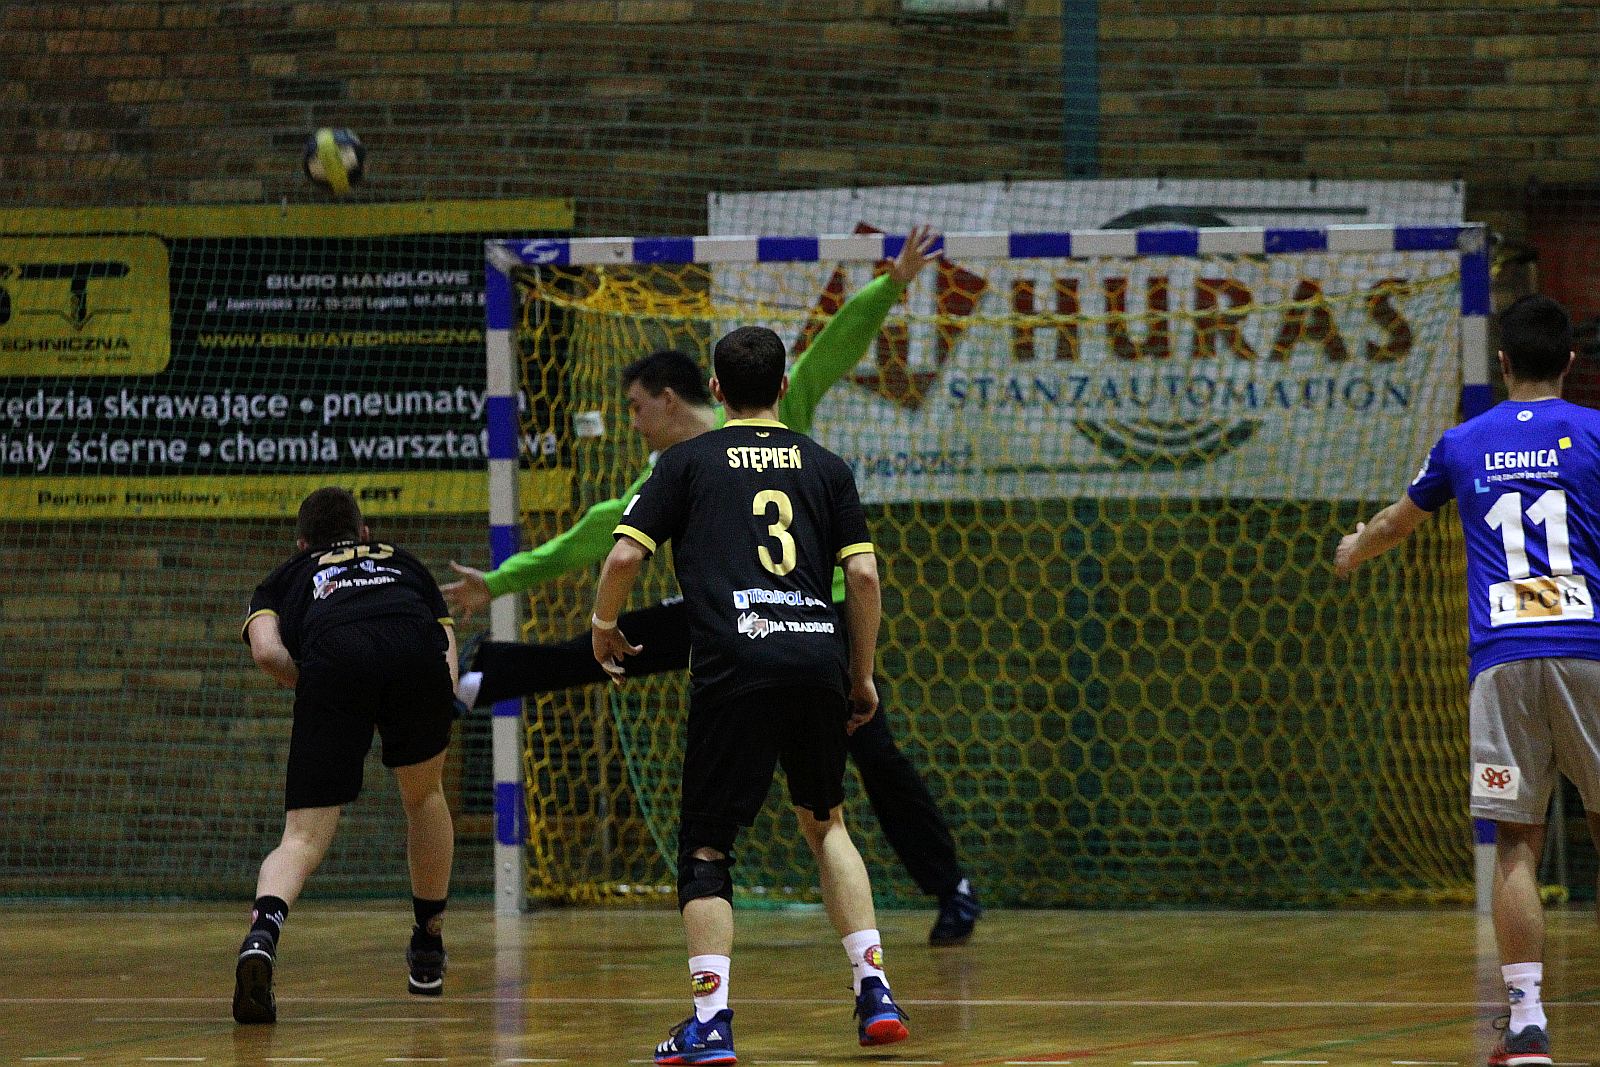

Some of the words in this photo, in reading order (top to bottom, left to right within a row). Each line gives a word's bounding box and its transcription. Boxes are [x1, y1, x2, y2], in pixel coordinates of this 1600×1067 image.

[266, 274, 336, 290] BIURO
[342, 270, 470, 288] HANDLOWE
[0, 388, 93, 427] ędzia
[104, 388, 289, 426] skrawające
[67, 432, 188, 464] ścierne
[219, 430, 338, 463] chemia
[727, 444, 803, 472] STĘPIEŃ
[1485, 449, 1558, 470] LEGNICA
[752, 489, 797, 577] 3
[1484, 489, 1573, 581] 11
